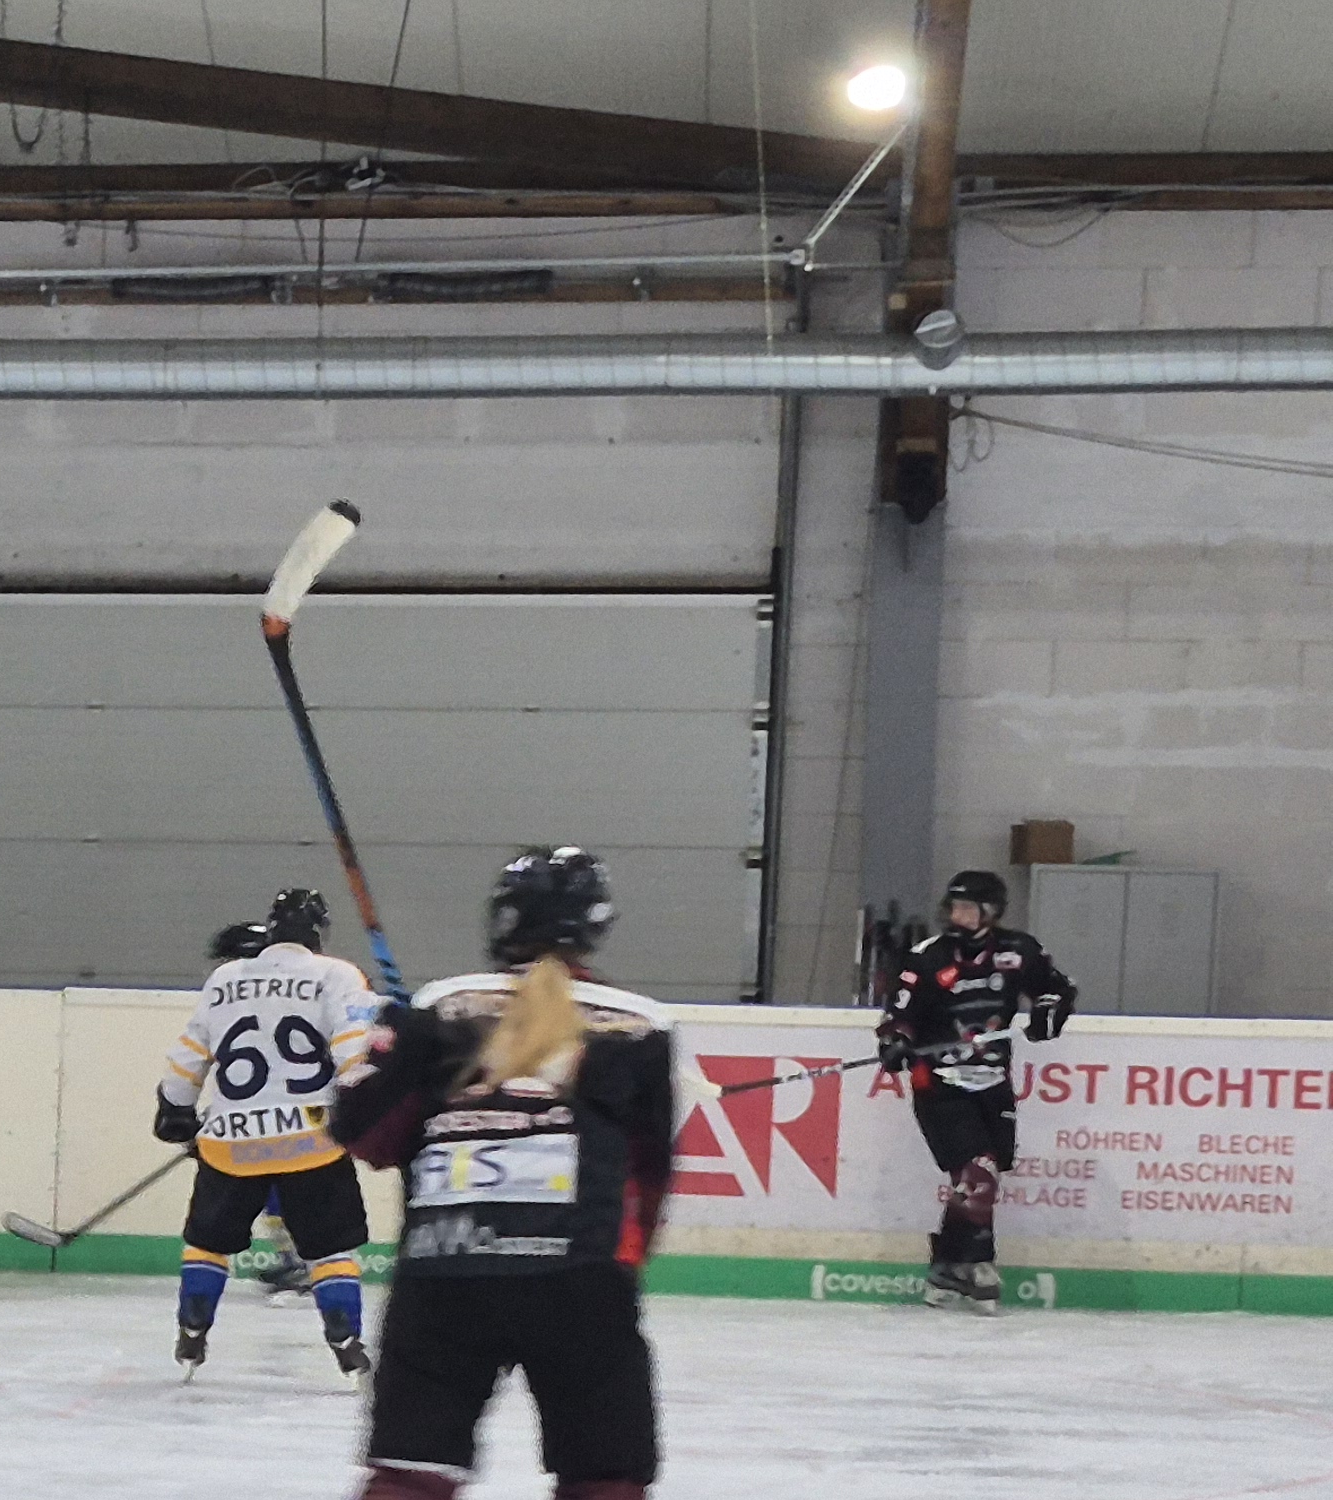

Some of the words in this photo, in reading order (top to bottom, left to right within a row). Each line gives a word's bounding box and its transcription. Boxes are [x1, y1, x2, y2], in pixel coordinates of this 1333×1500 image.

[215, 1014, 336, 1100] 69
[203, 1106, 303, 1139] ORTM
[1055, 1127, 1163, 1152] RÖHREN
[1198, 1133, 1295, 1155] BLECHE
[1014, 1157, 1097, 1180] ZEUGE
[1136, 1161, 1295, 1185] MASCHINEN
[1119, 1189, 1293, 1214] EISENWAREN
